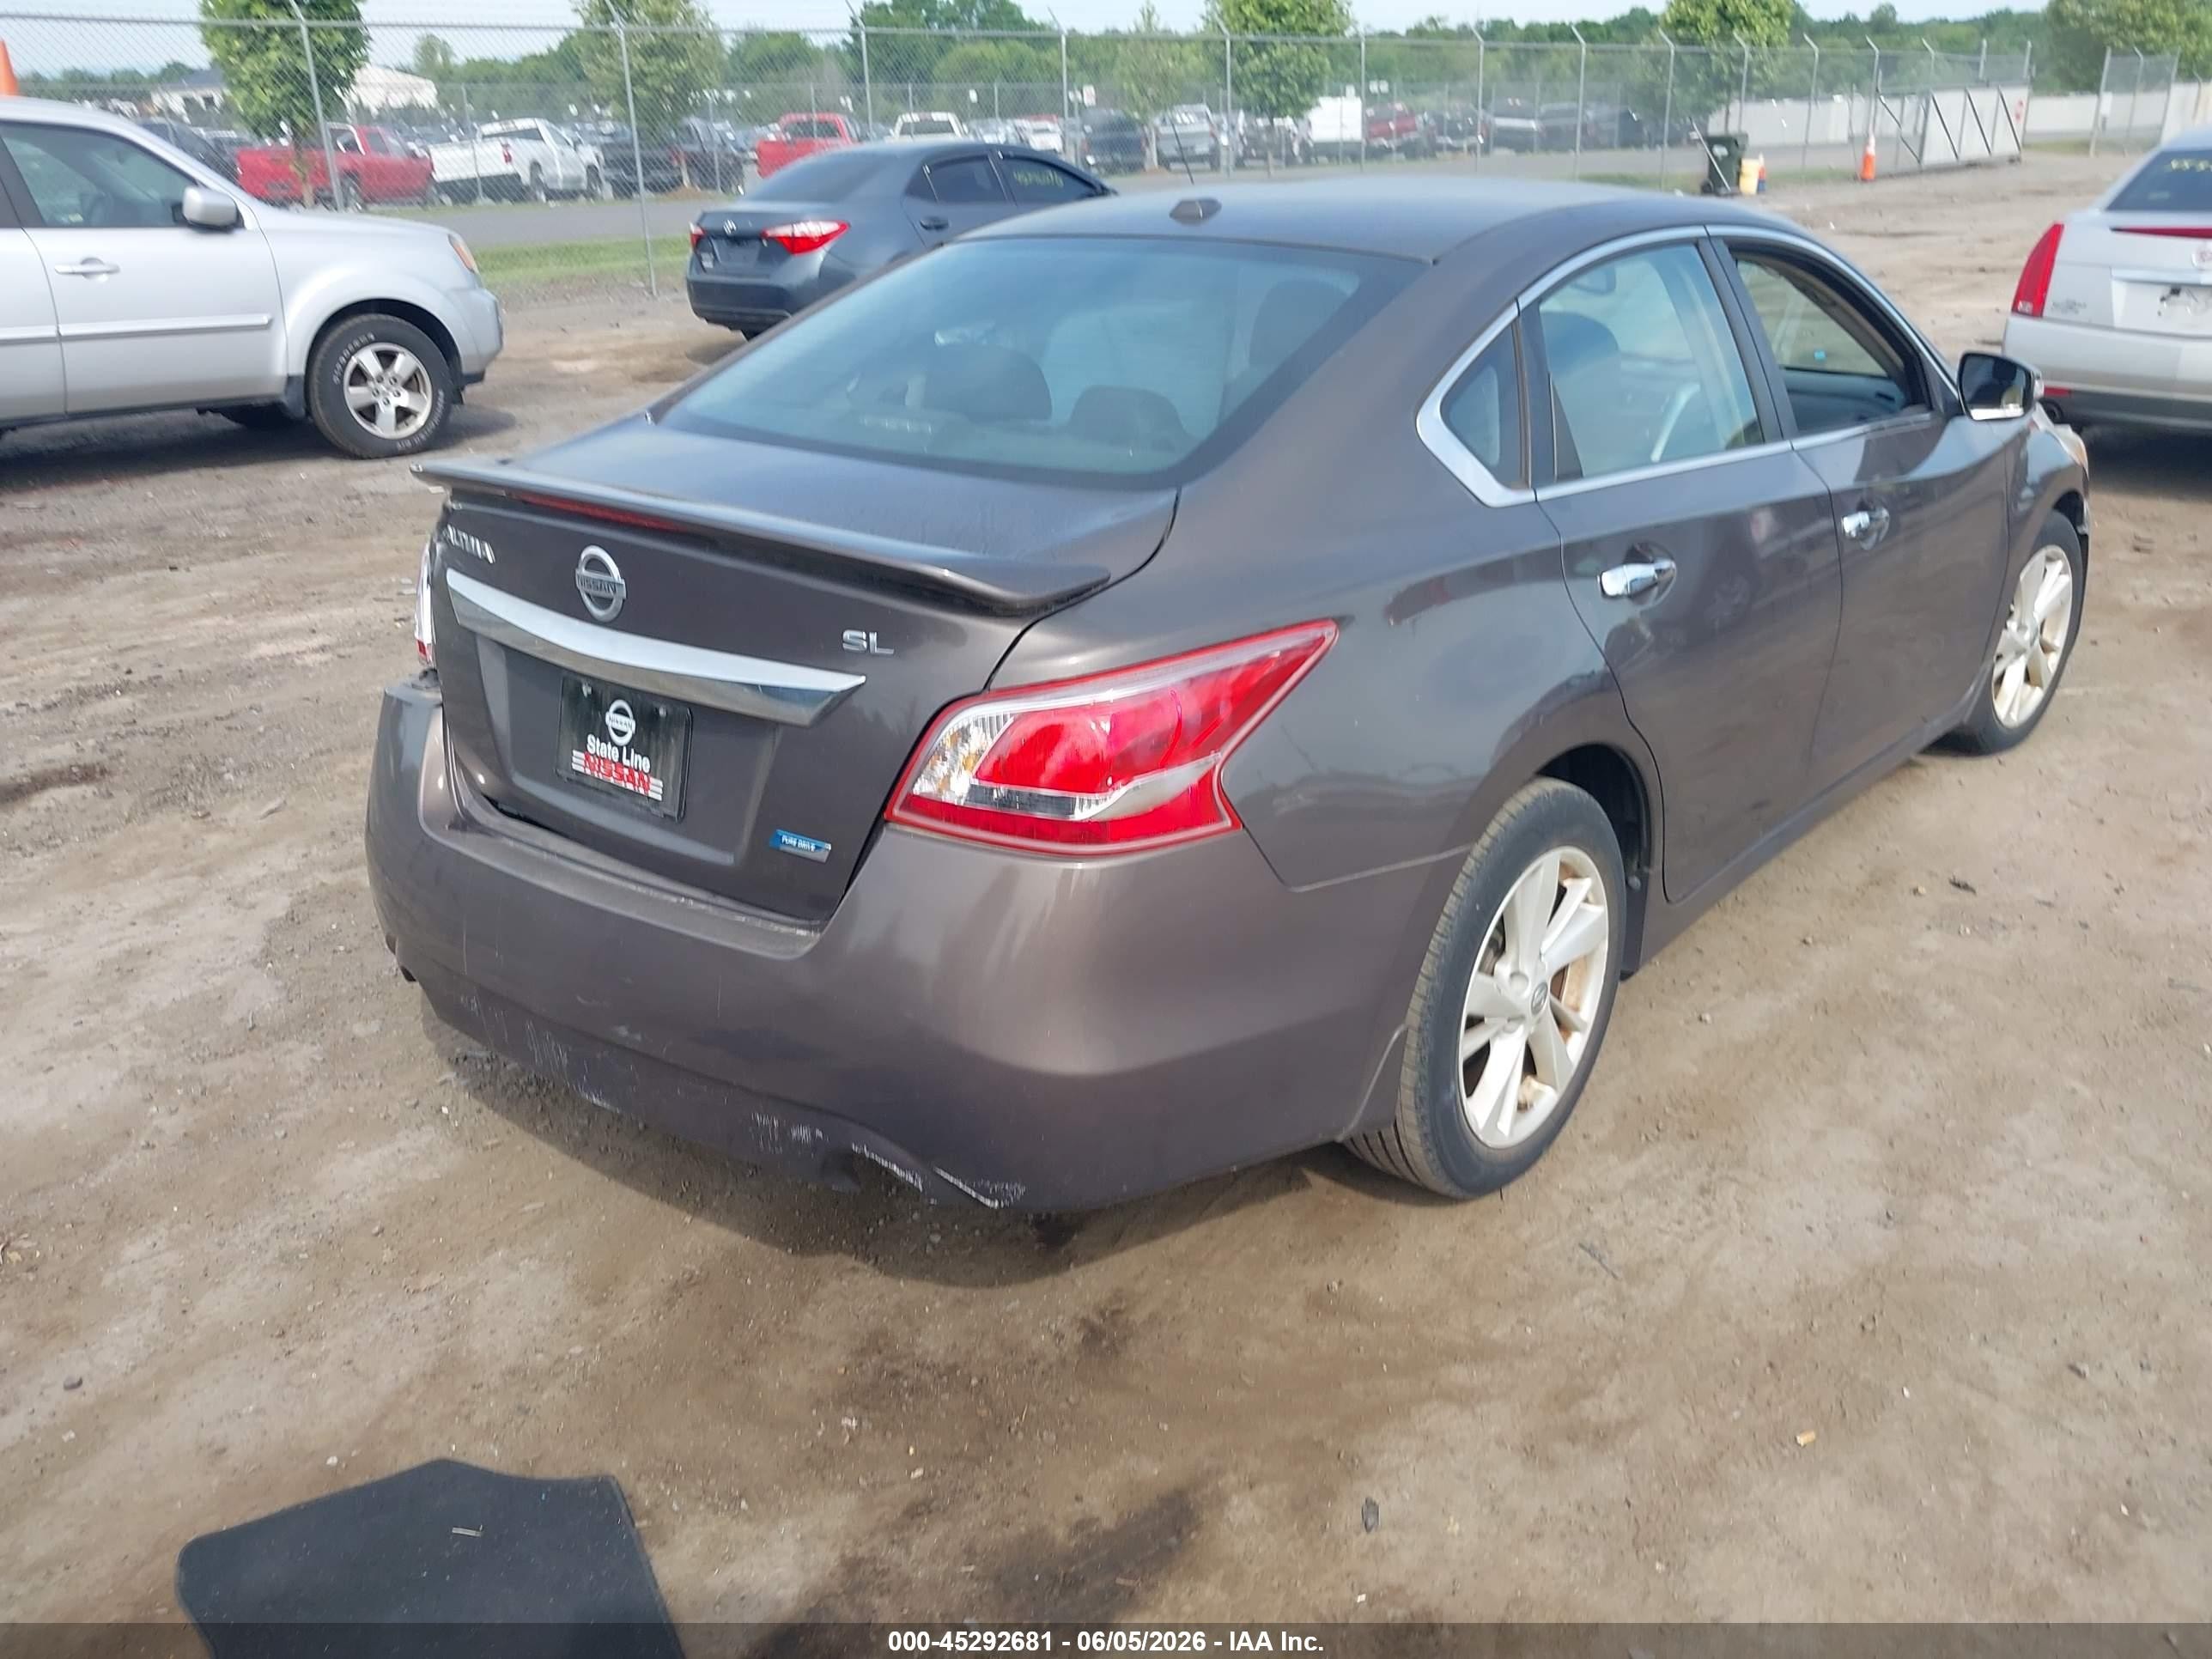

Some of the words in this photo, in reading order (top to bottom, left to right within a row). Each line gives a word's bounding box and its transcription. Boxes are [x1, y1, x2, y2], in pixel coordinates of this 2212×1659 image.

[577, 573, 617, 596] NISSAN
[842, 629, 895, 654] SL
[586, 733, 620, 763] State
[622, 745, 651, 774] Line
[584, 751, 652, 796] NISSAN
